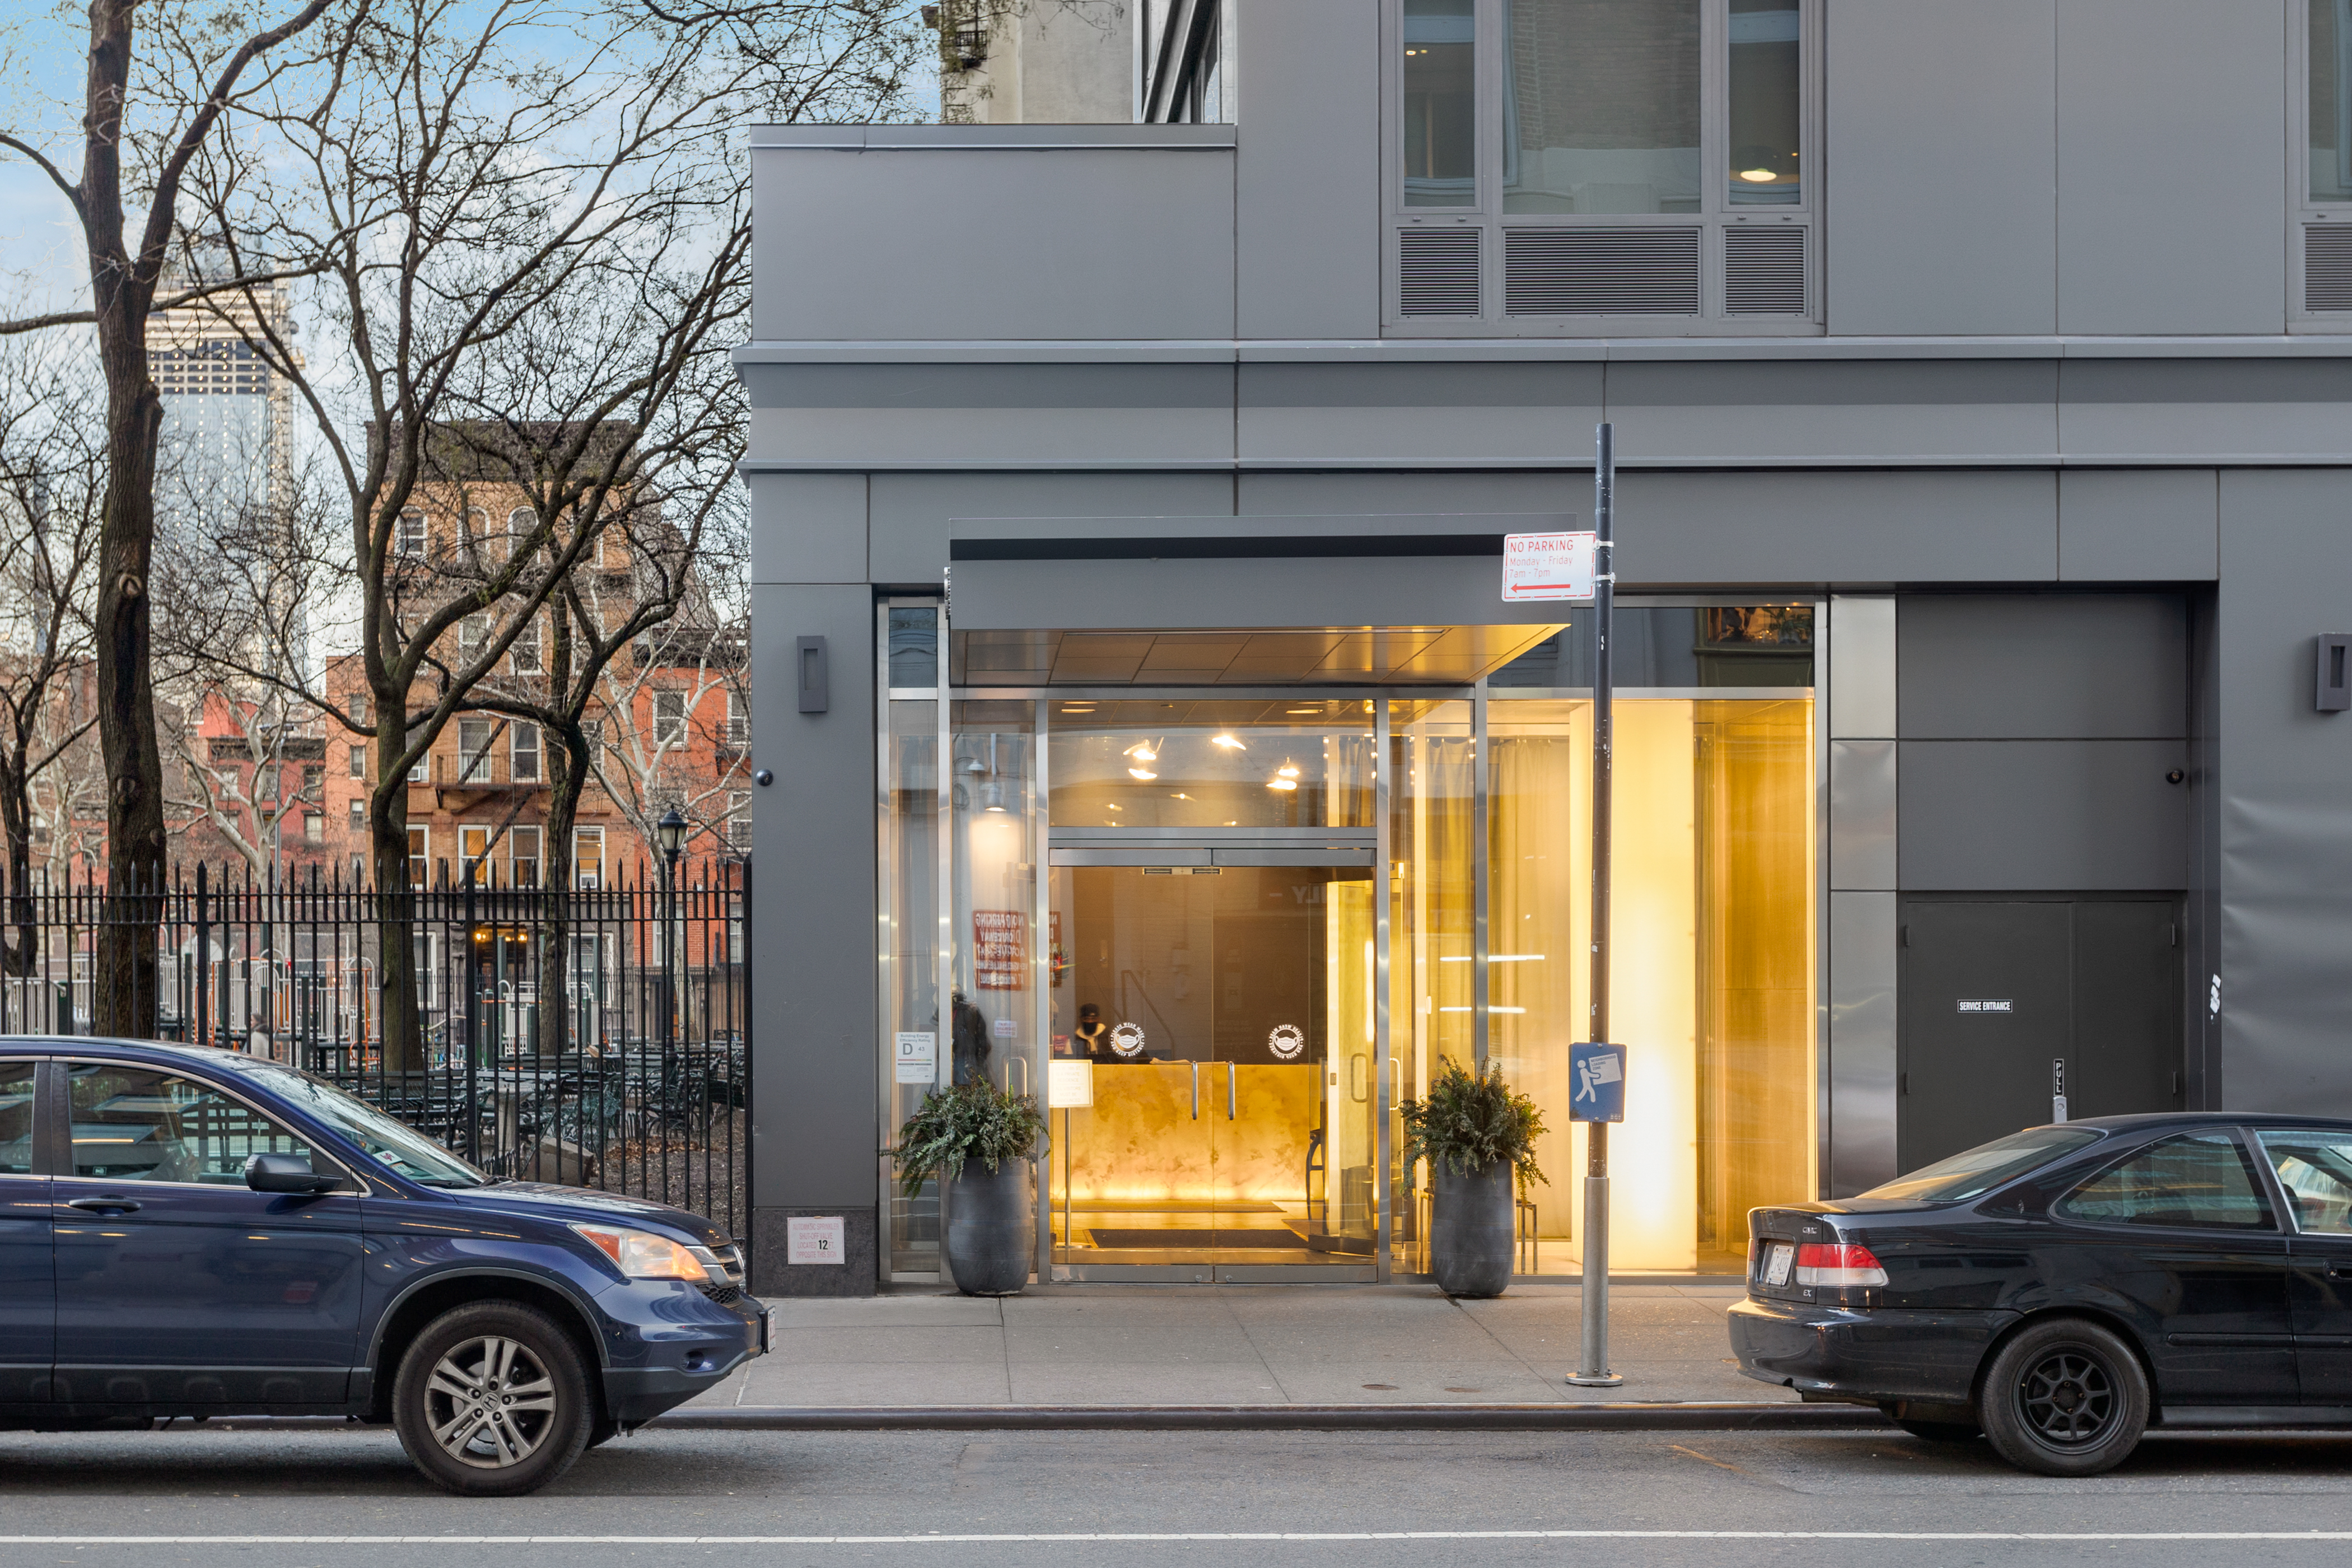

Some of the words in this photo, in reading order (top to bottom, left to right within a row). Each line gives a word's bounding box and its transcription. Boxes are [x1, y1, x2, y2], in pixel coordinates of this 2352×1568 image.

[1510, 542, 1524, 553] NO
[1528, 539, 1574, 552] PARKING
[1510, 557, 1540, 567] Monday
[1548, 556, 1573, 566] Friday
[1510, 569, 1525, 578] 7am
[1534, 568, 1550, 579] 7pm
[1959, 1001, 1981, 1011] SERVICE
[1982, 1001, 2010, 1011] ENTRANCE
[1110, 1024, 1122, 1037] PLEASE
[1136, 1026, 1145, 1038] MASK
[903, 1043, 913, 1055] D
[818, 1239, 828, 1250] 12
